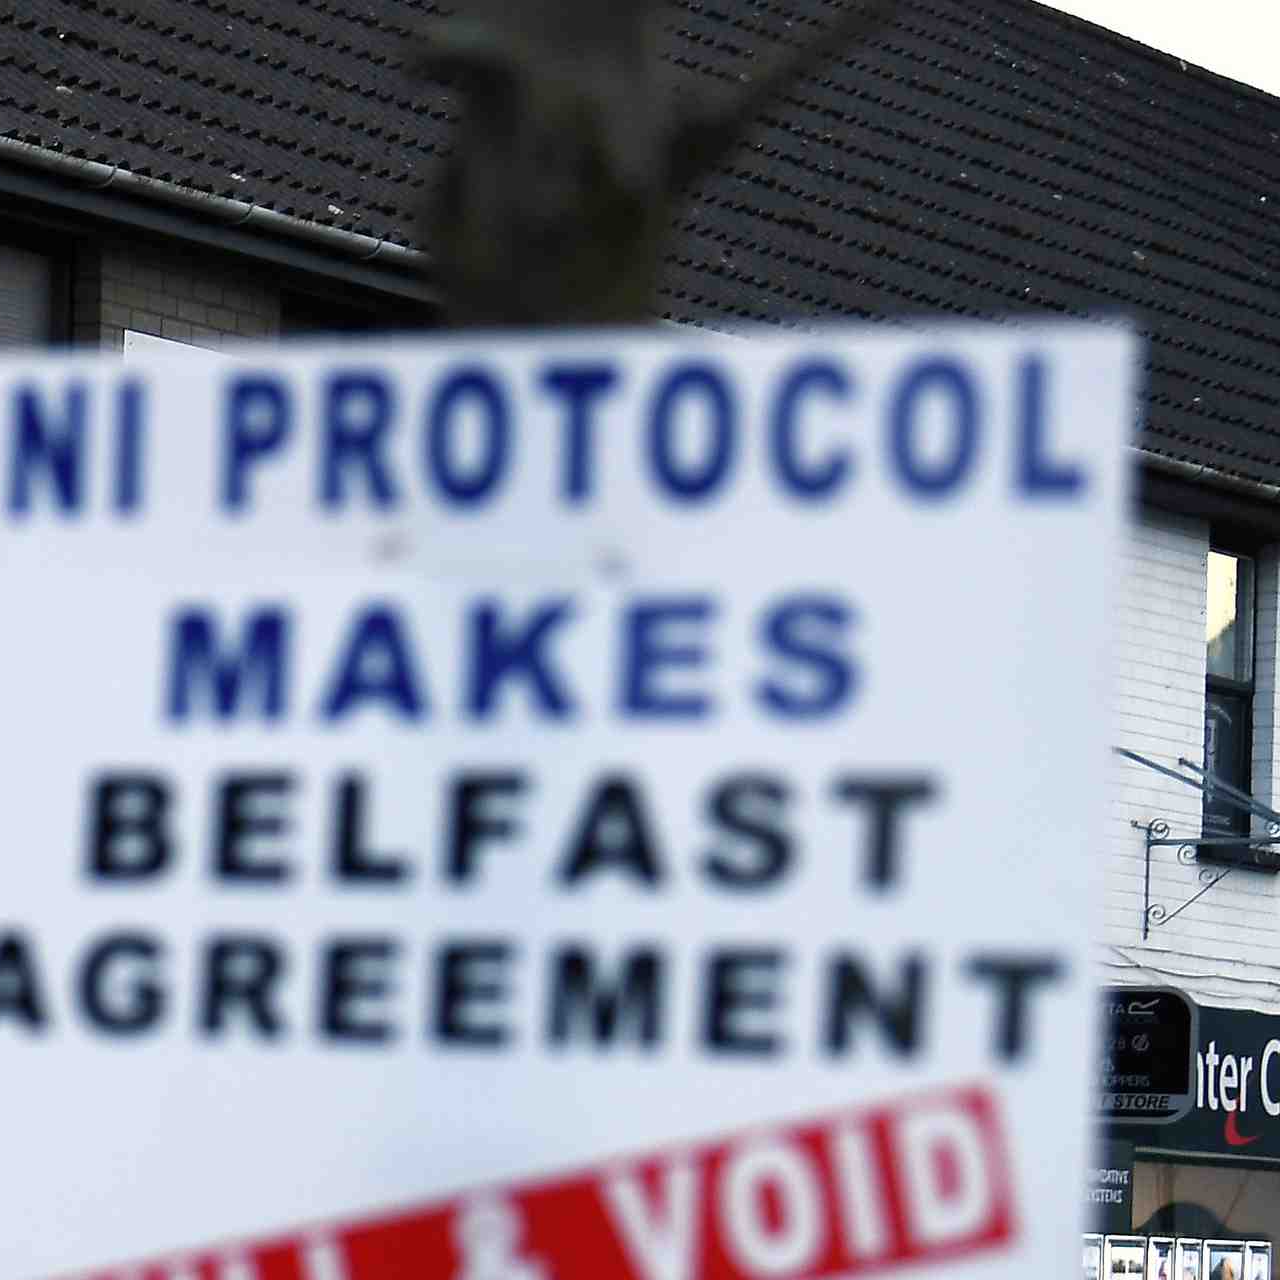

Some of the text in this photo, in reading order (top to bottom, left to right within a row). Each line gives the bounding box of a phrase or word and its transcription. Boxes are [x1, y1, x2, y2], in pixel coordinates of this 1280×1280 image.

[5, 352, 1092, 520] NI PROTOCOL
[162, 592, 866, 724] MAKES
[82, 770, 943, 892] BELFAST
[1113, 1094, 1169, 1111] STORE
